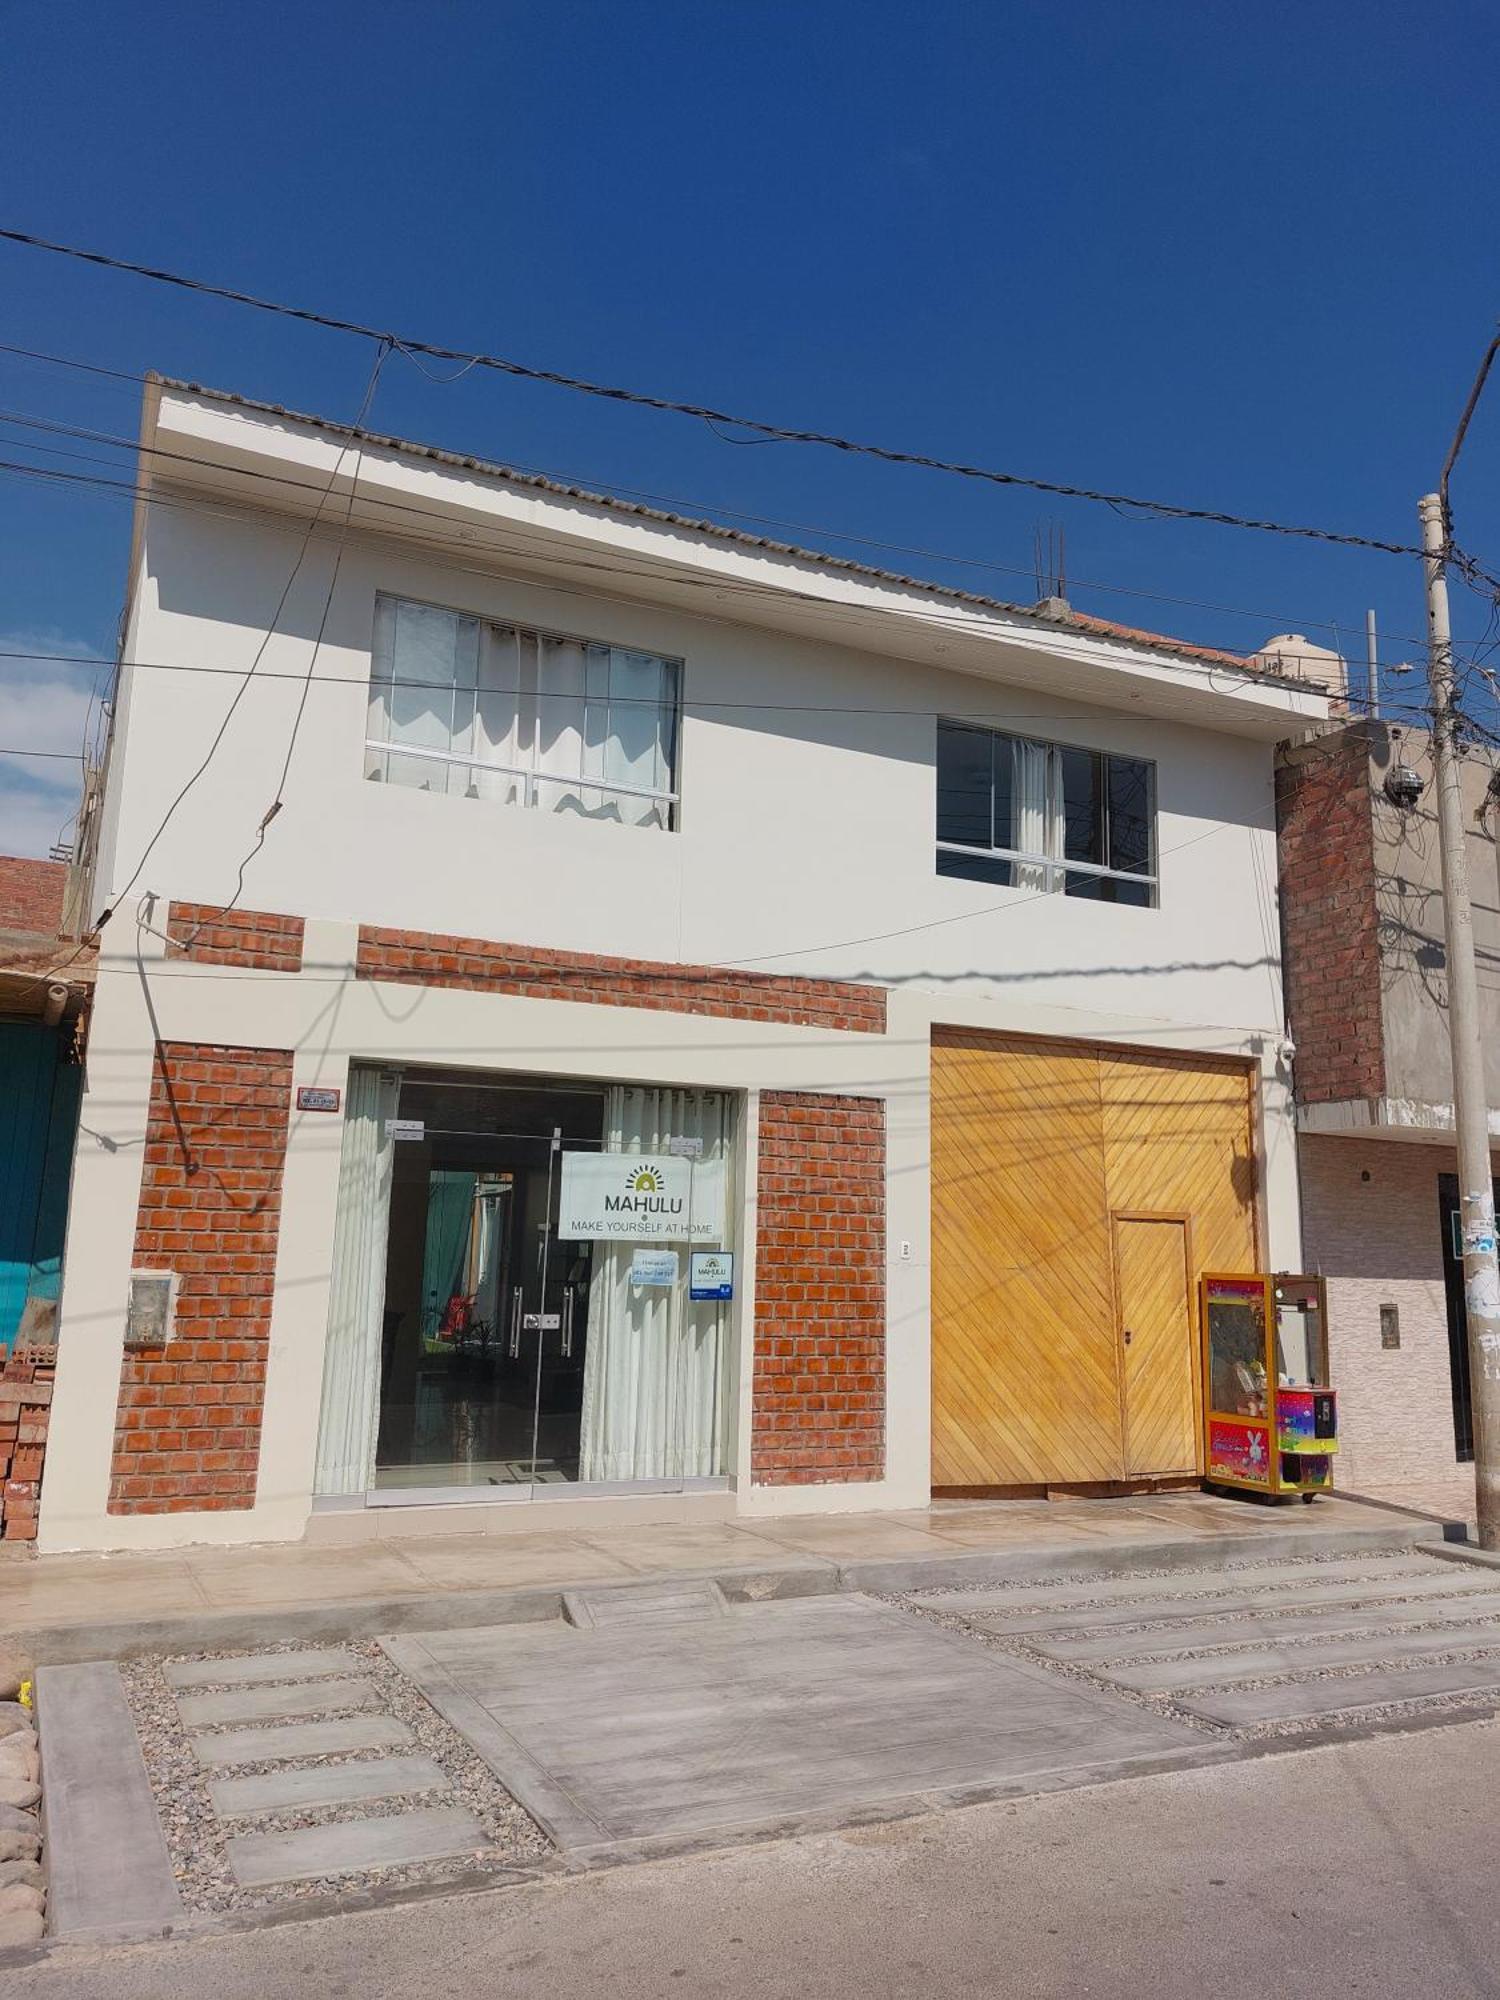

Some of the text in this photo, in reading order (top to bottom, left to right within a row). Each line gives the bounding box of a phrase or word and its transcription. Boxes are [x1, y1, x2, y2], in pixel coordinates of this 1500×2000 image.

[605, 1195, 682, 1214] MAHULU
[571, 1220, 713, 1235] MAKE YOURSELF AT HOME
